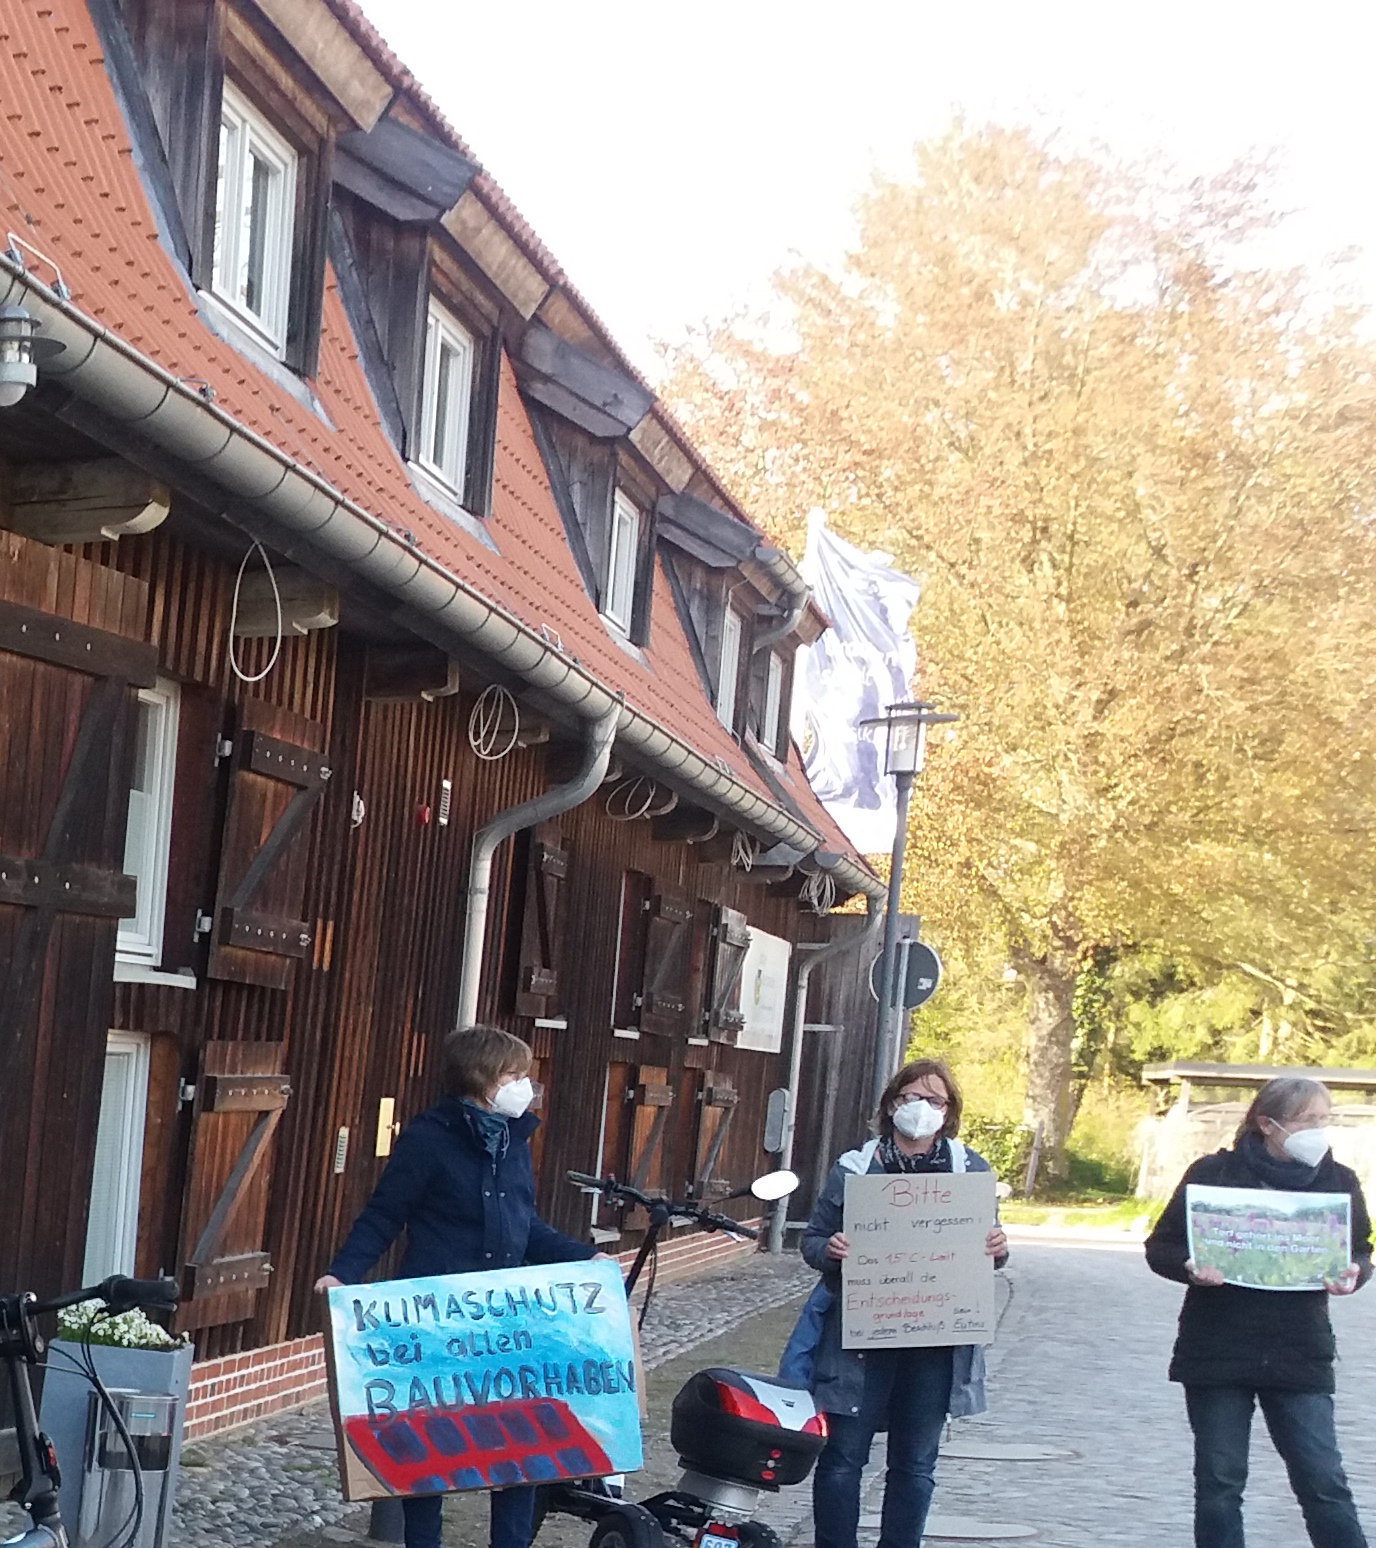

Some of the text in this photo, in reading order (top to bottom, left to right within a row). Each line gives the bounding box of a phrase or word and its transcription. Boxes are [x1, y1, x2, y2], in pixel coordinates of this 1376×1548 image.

[882, 1178, 952, 1208] Bitte
[854, 1218, 890, 1233] nicht
[352, 1282, 608, 1332] KLIMASCHUTZ
[366, 1330, 533, 1367] bei allen
[363, 1359, 637, 1429] BAUVORHABEN
